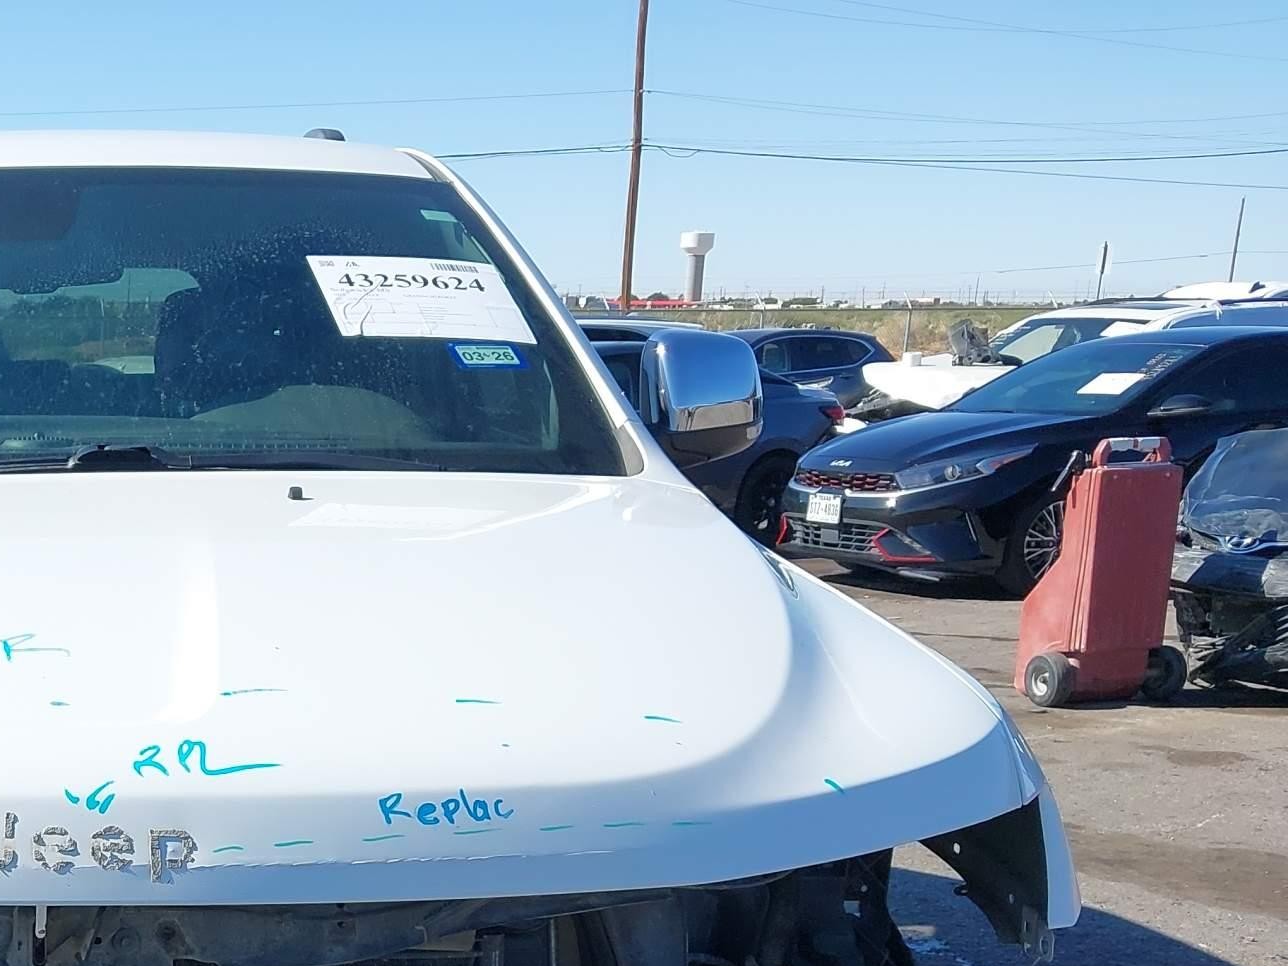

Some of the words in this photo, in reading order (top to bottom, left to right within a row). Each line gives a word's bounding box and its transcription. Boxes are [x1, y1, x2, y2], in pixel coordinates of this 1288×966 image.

[338, 273, 486, 293] 43259624
[462, 351, 484, 361] 03
[492, 351, 515, 361] 26
[378, 788, 514, 825] Replac
